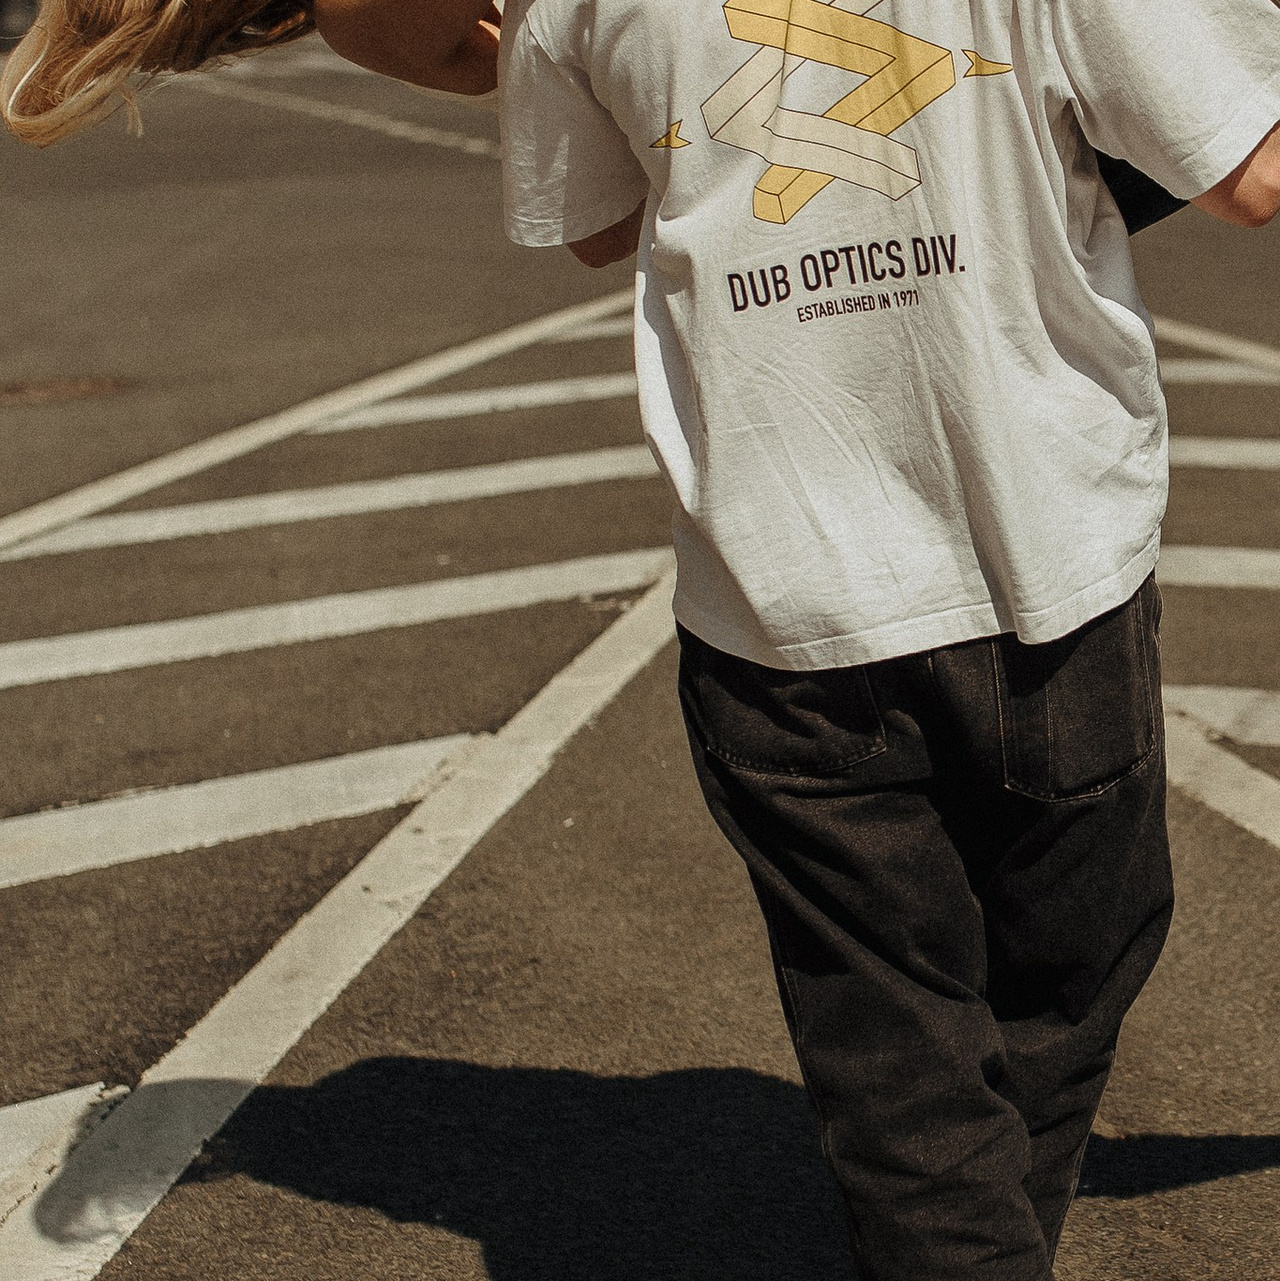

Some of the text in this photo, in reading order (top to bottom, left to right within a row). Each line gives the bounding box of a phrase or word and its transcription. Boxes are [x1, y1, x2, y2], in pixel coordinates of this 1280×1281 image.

[727, 234, 966, 312] DUB OPTICS DIV.
[797, 289, 920, 322] ESTABLISHED IN 1971
